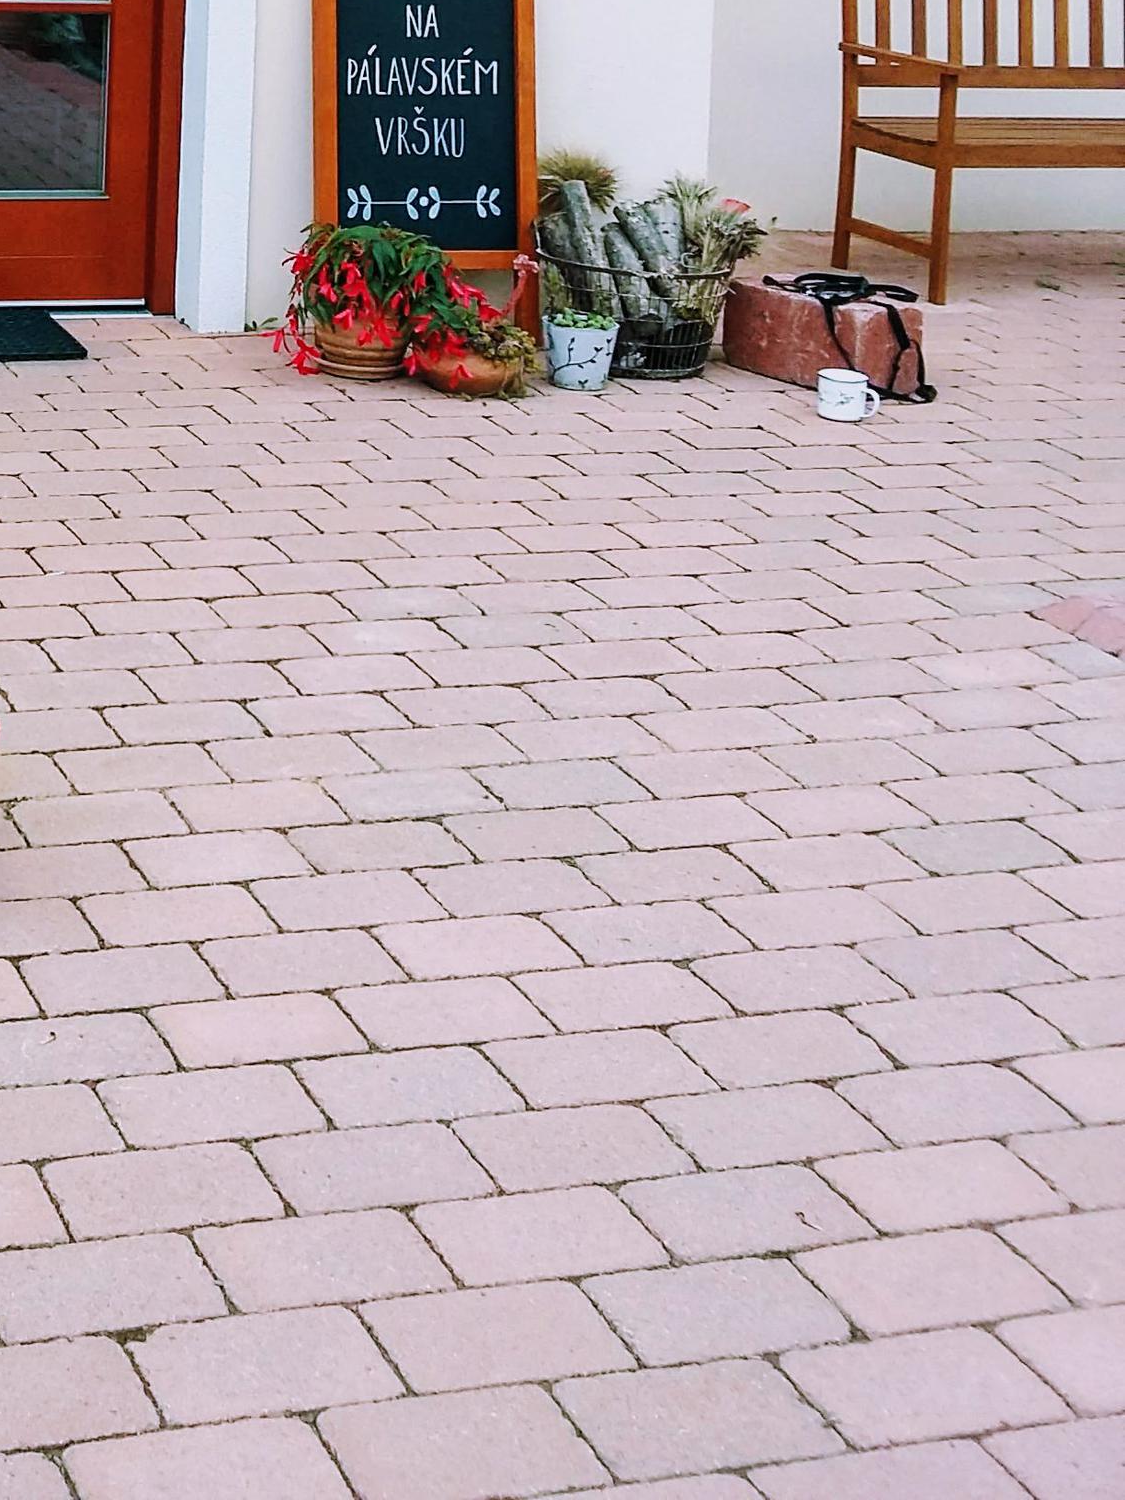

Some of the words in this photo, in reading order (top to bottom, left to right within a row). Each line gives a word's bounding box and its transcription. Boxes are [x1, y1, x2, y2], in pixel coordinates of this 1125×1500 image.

[405, 4, 440, 38] NA
[347, 44, 498, 96] PÁLAVSKÉM
[375, 106, 466, 159] VRŠKU
